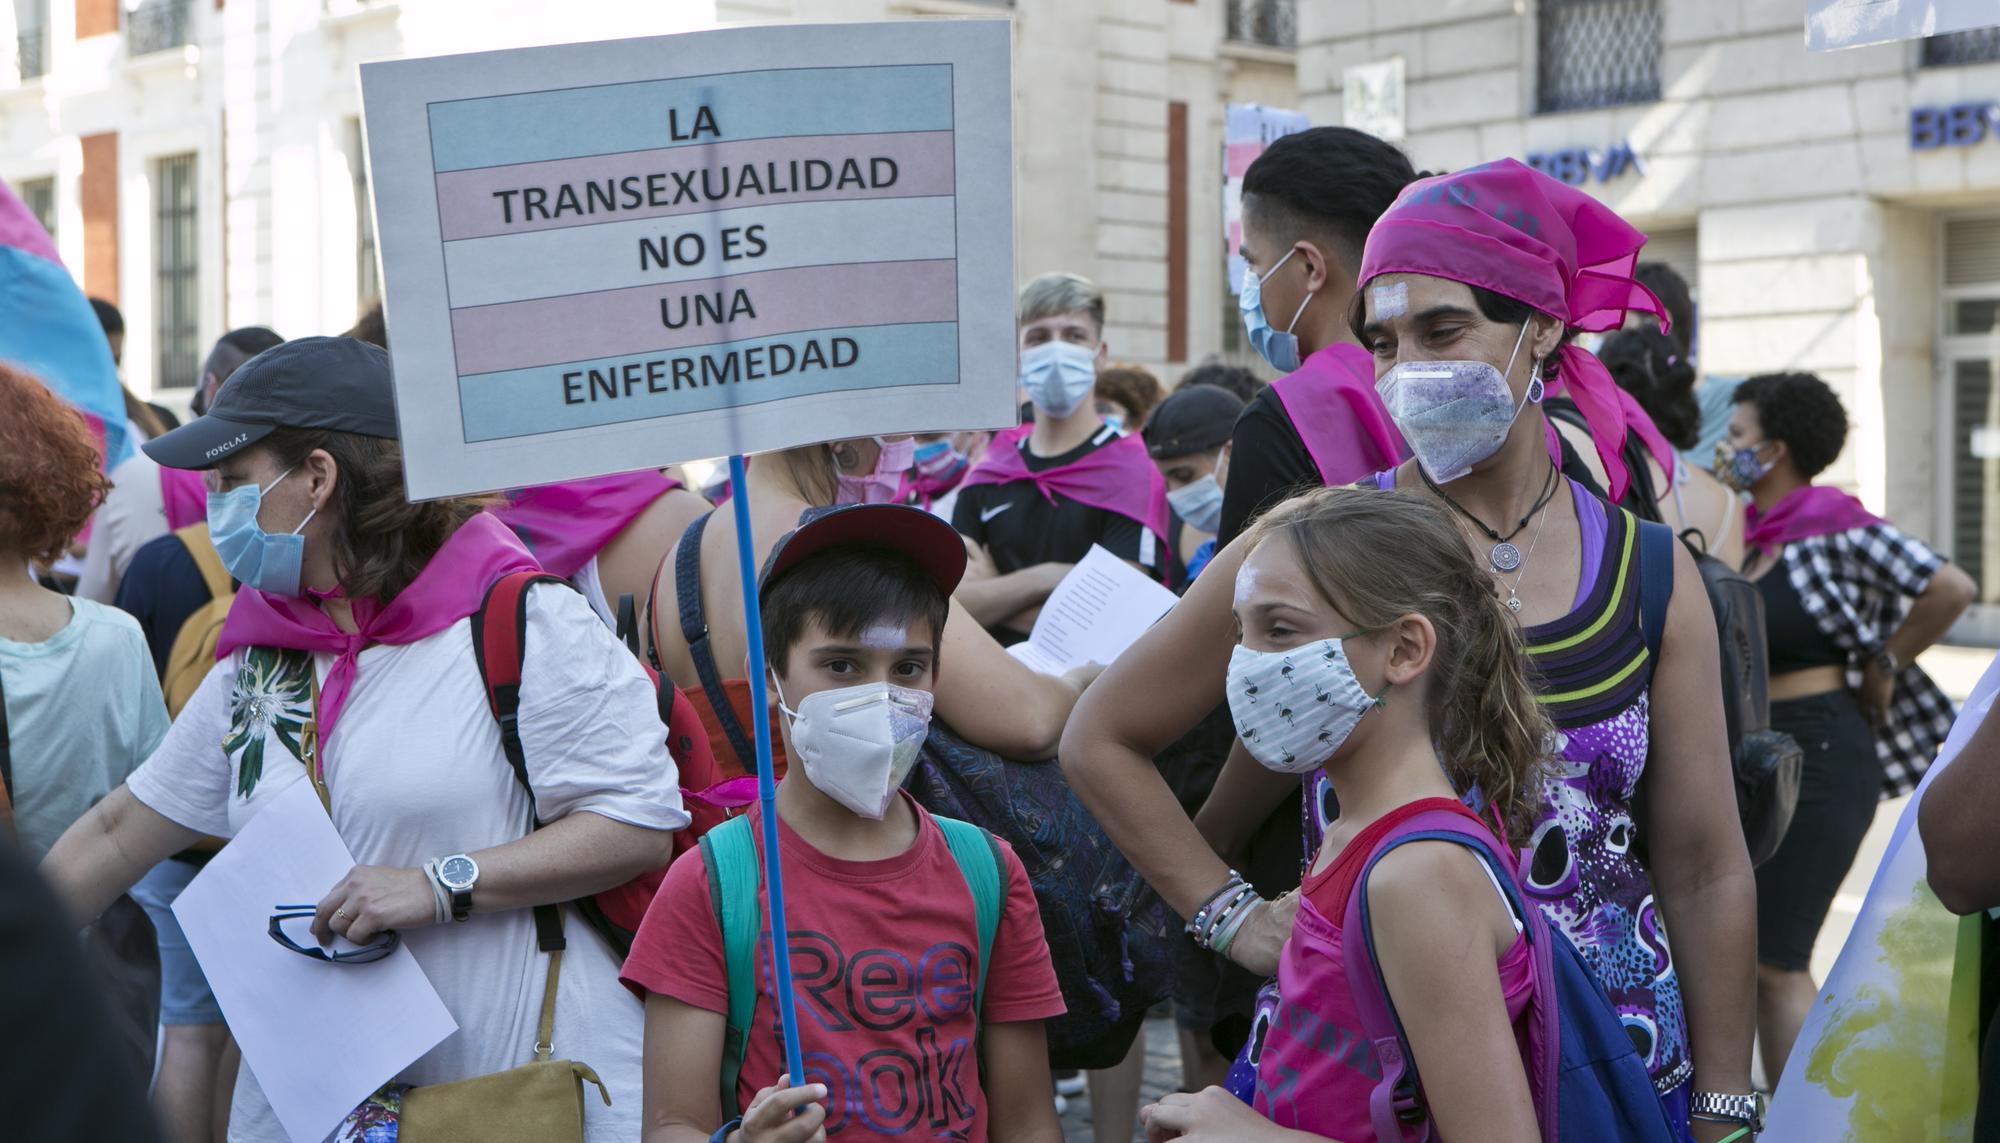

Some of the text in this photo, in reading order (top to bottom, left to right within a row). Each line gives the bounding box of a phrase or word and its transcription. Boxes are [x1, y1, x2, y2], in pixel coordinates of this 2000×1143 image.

[668, 105, 721, 142] LA
[493, 156, 899, 224] TRANSEXUALIDAD
[638, 224, 767, 271] NO ES
[659, 288, 756, 329] UNA
[561, 336, 859, 405] ENFERMEDAD
[206, 433, 248, 459] FORCLAZ
[760, 930, 973, 1032] Ree
